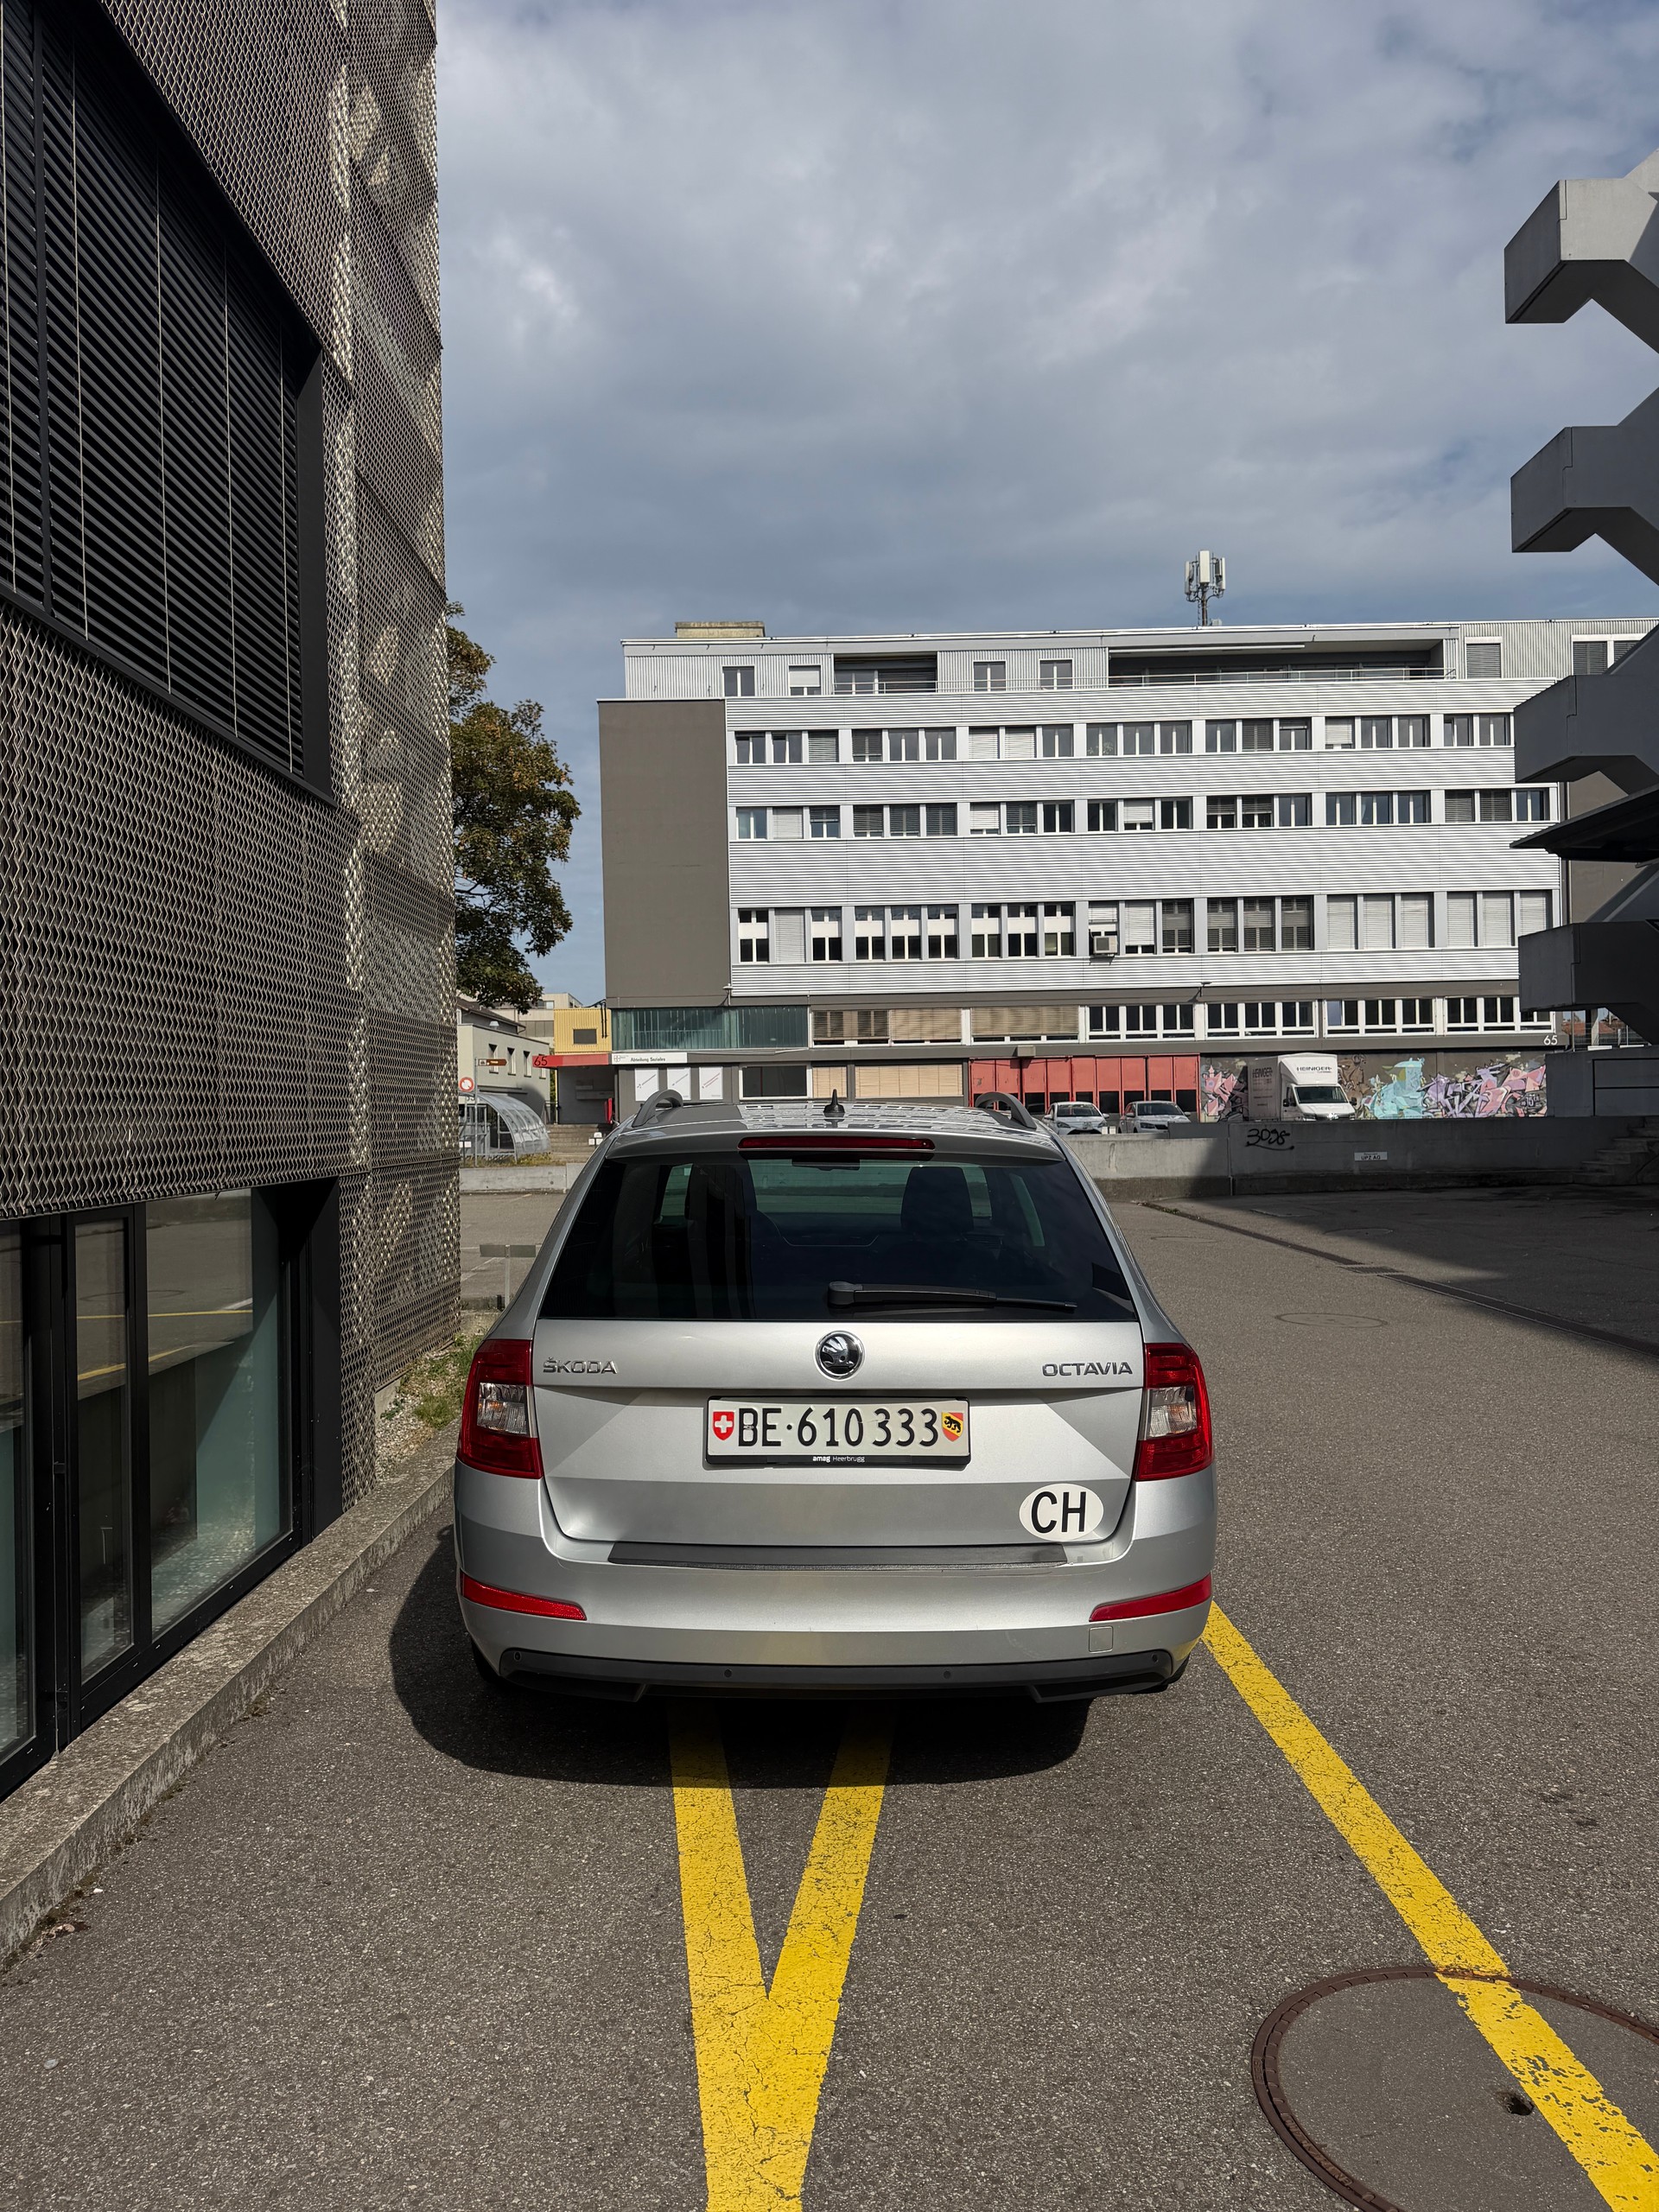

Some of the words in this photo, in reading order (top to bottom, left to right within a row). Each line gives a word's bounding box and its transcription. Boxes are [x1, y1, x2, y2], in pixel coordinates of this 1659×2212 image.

[1543, 1034, 1558, 1046] 65
[533, 1055, 548, 1066] 65
[543, 1357, 618, 1375] ŠKODA
[1041, 1362, 1134, 1377] OCTAVIA
[1031, 1491, 1086, 1534] CH
